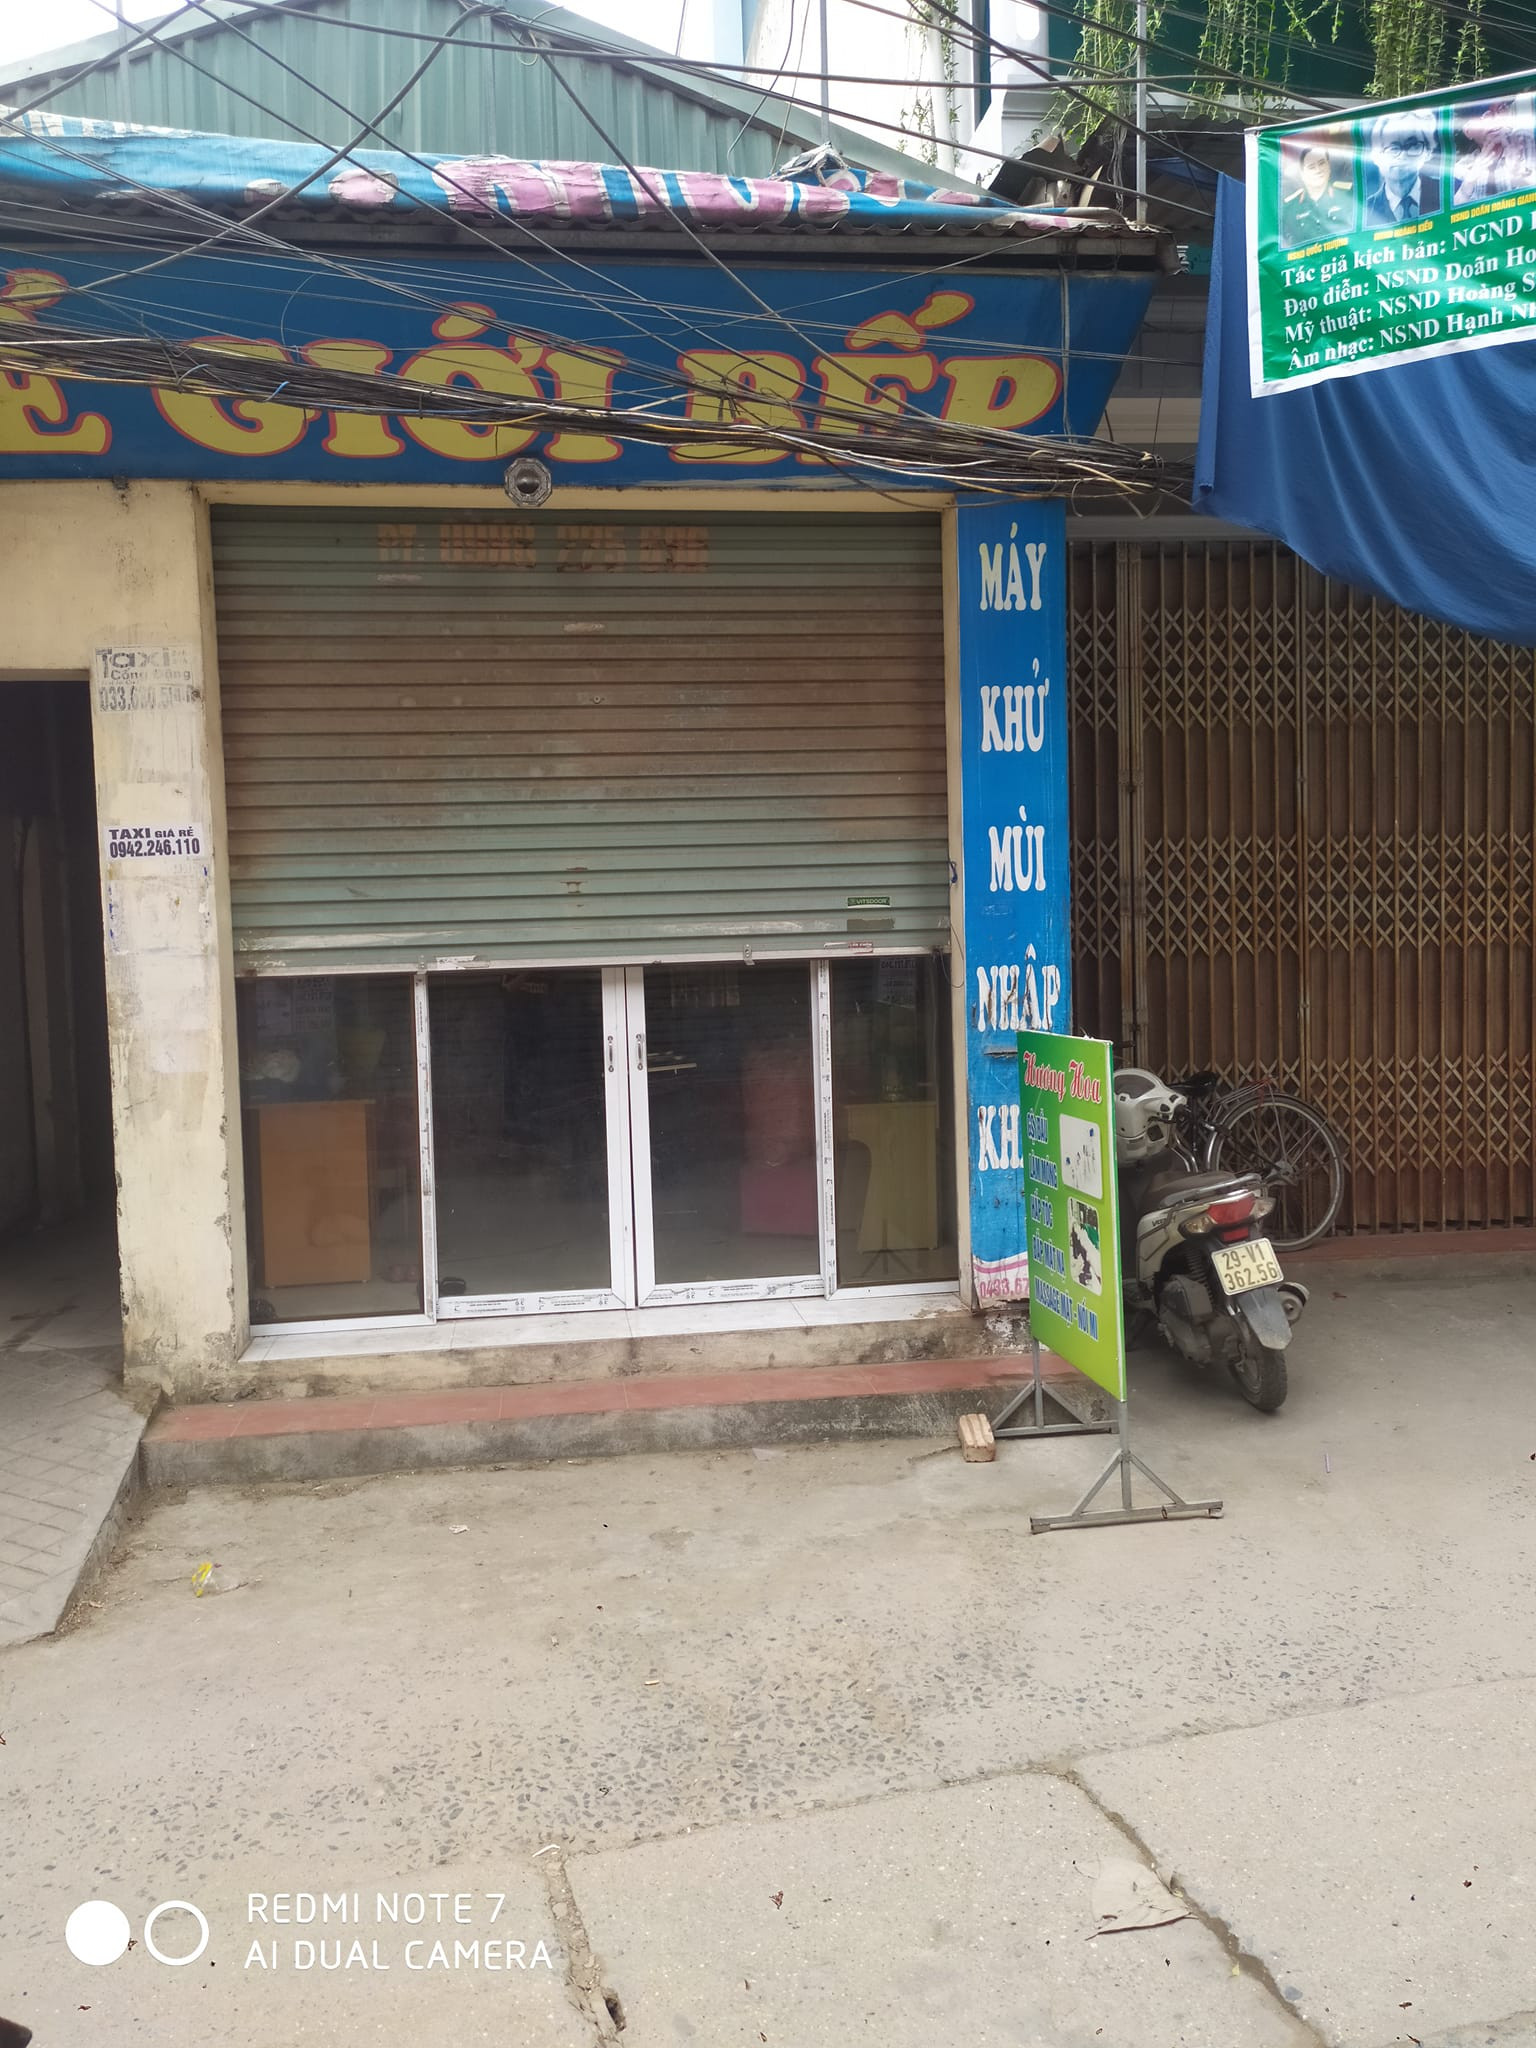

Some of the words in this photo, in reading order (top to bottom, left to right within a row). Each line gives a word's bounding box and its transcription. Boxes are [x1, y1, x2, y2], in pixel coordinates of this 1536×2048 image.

[1281, 265, 1316, 288] Tác
[1320, 254, 1348, 283] giả
[1354, 246, 1395, 271] kịch
[1402, 240, 1446, 261] bản:
[1452, 215, 1523, 251] NGND
[1284, 296, 1318, 317] Đạo
[1323, 278, 1369, 306] diễn:
[1375, 267, 1439, 293] NSND
[1445, 256, 1499, 282] Doãn
[1285, 321, 1315, 344] Mỹ
[1320, 307, 1371, 334] thuật:
[1379, 290, 1441, 319] NSND
[1447, 282, 1517, 305] Hoàng
[1288, 347, 1319, 371] Âm
[1325, 337, 1374, 360] nhạc:
[1379, 318, 1440, 348] NSND
[1447, 307, 1503, 335] Hạnh
[152, 302, 627, 462] GIỚI
[670, 290, 1063, 465] BẾP
[979, 522, 1047, 611] MÁY
[980, 657, 1050, 753] KHỬ
[109, 827, 151, 841] TAXI
[109, 837, 201, 859] 0942.246.110
[988, 805, 1047, 893] MÙI
[1023, 1050, 1066, 1103] Hương
[1068, 1059, 1102, 1104] Hoa
[1221, 1244, 1266, 1271] 29-V1
[1223, 1260, 1278, 1291] 362.56
[1034, 1275, 1060, 1315] MASSAGE
